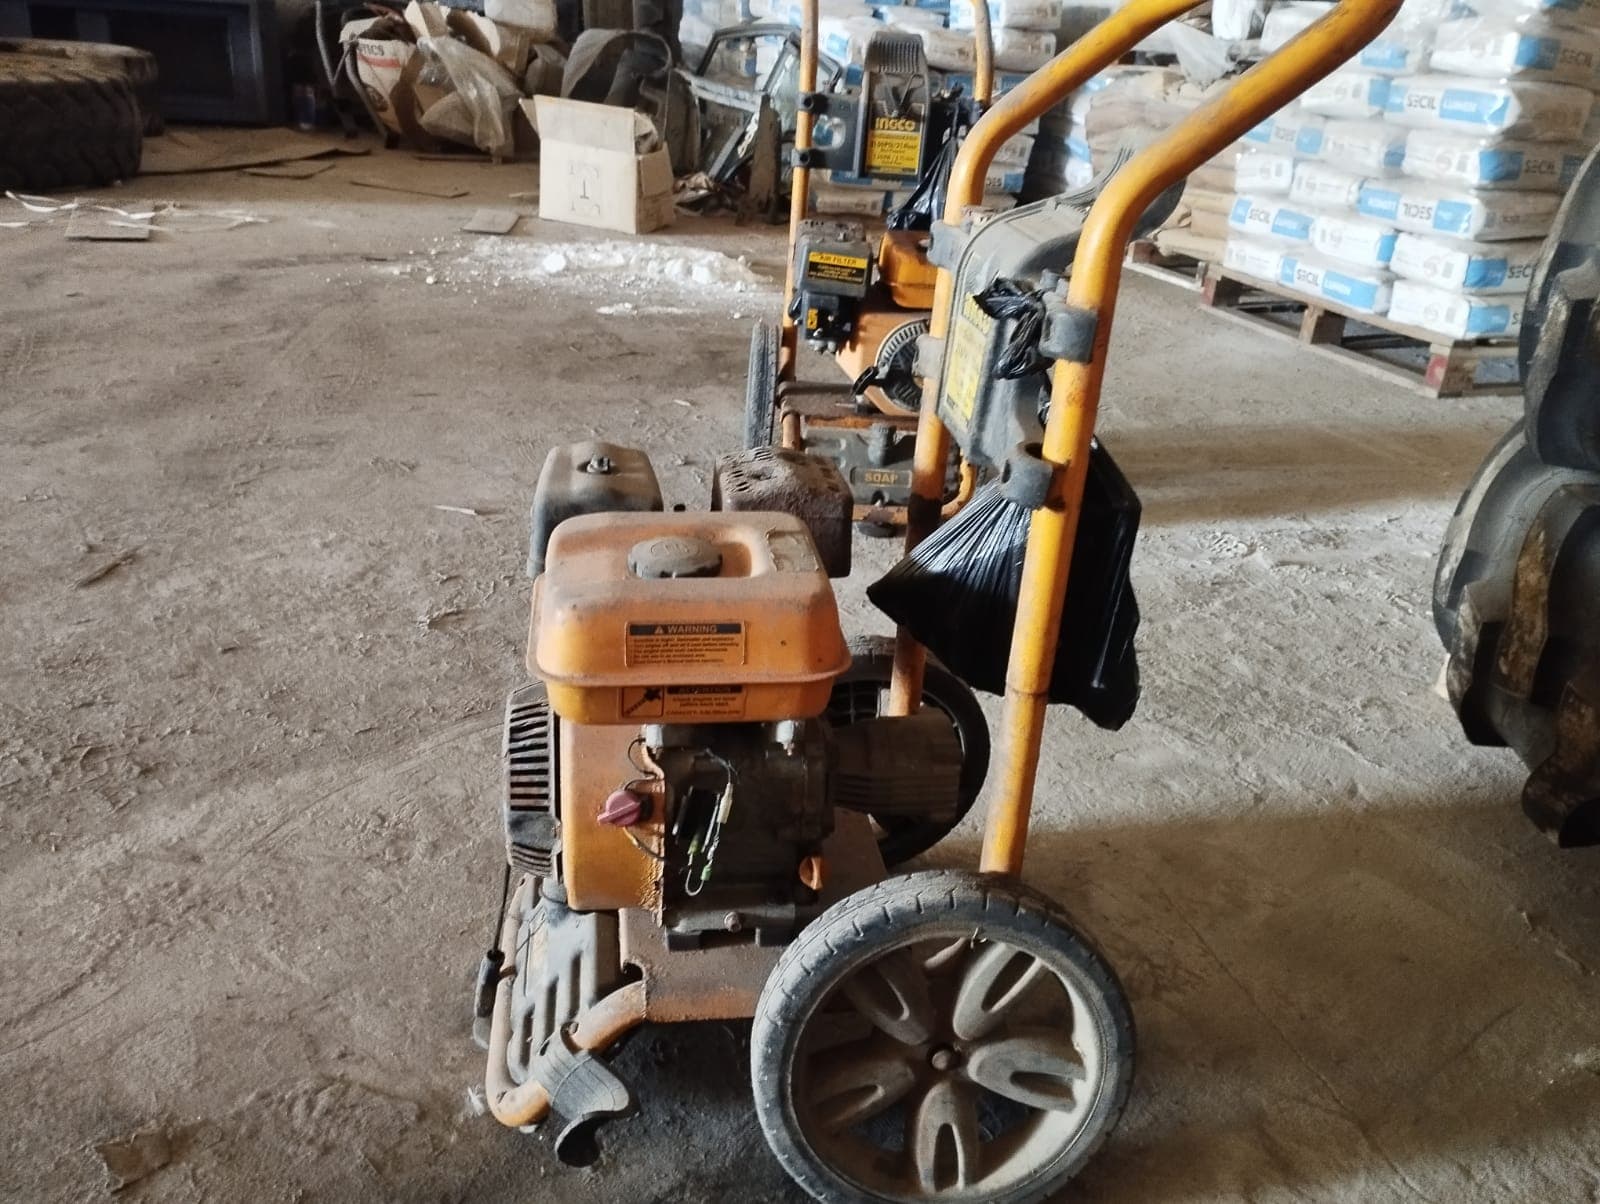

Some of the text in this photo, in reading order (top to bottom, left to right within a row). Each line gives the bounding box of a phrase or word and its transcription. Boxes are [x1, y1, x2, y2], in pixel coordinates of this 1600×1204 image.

[1407, 93, 1437, 110] SECIL
[1525, 159, 1557, 175] SECIL
[1249, 208, 1271, 225] SECIL
[1296, 268, 1320, 287] SECIL
[865, 471, 898, 485] SOAP
[667, 624, 718, 634] WARNING
